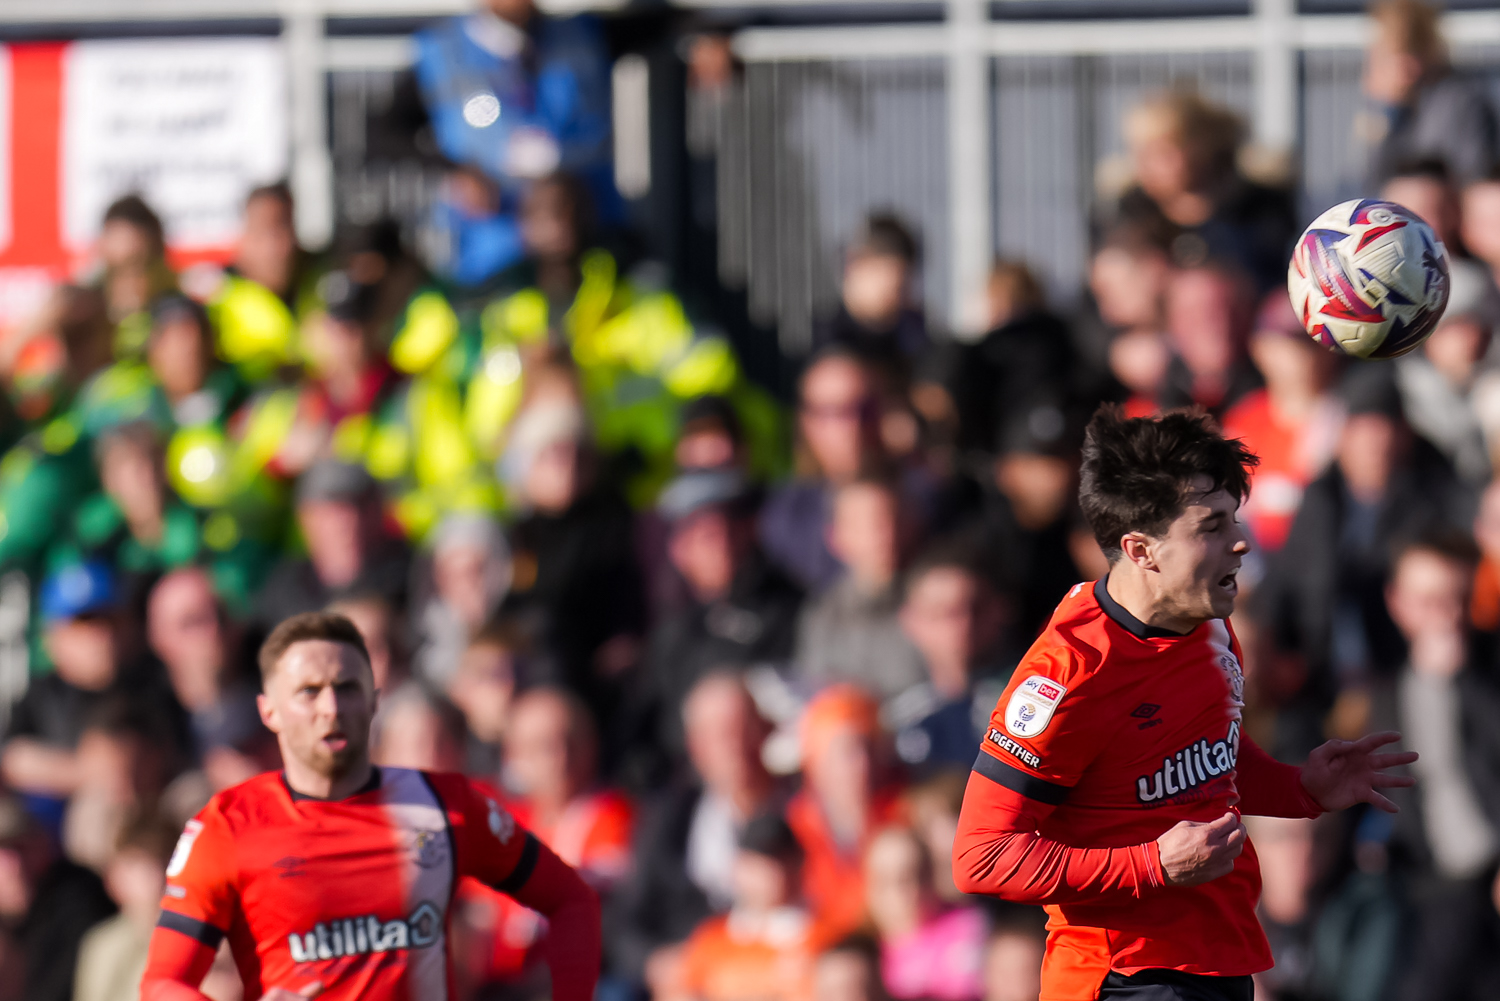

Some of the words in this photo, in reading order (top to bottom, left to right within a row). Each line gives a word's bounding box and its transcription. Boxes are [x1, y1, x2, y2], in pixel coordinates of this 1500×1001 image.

[1040, 685, 1057, 698] bet
[1013, 720, 1026, 732] EFL
[1138, 739, 1232, 802] utilita
[288, 913, 409, 963] utilita
